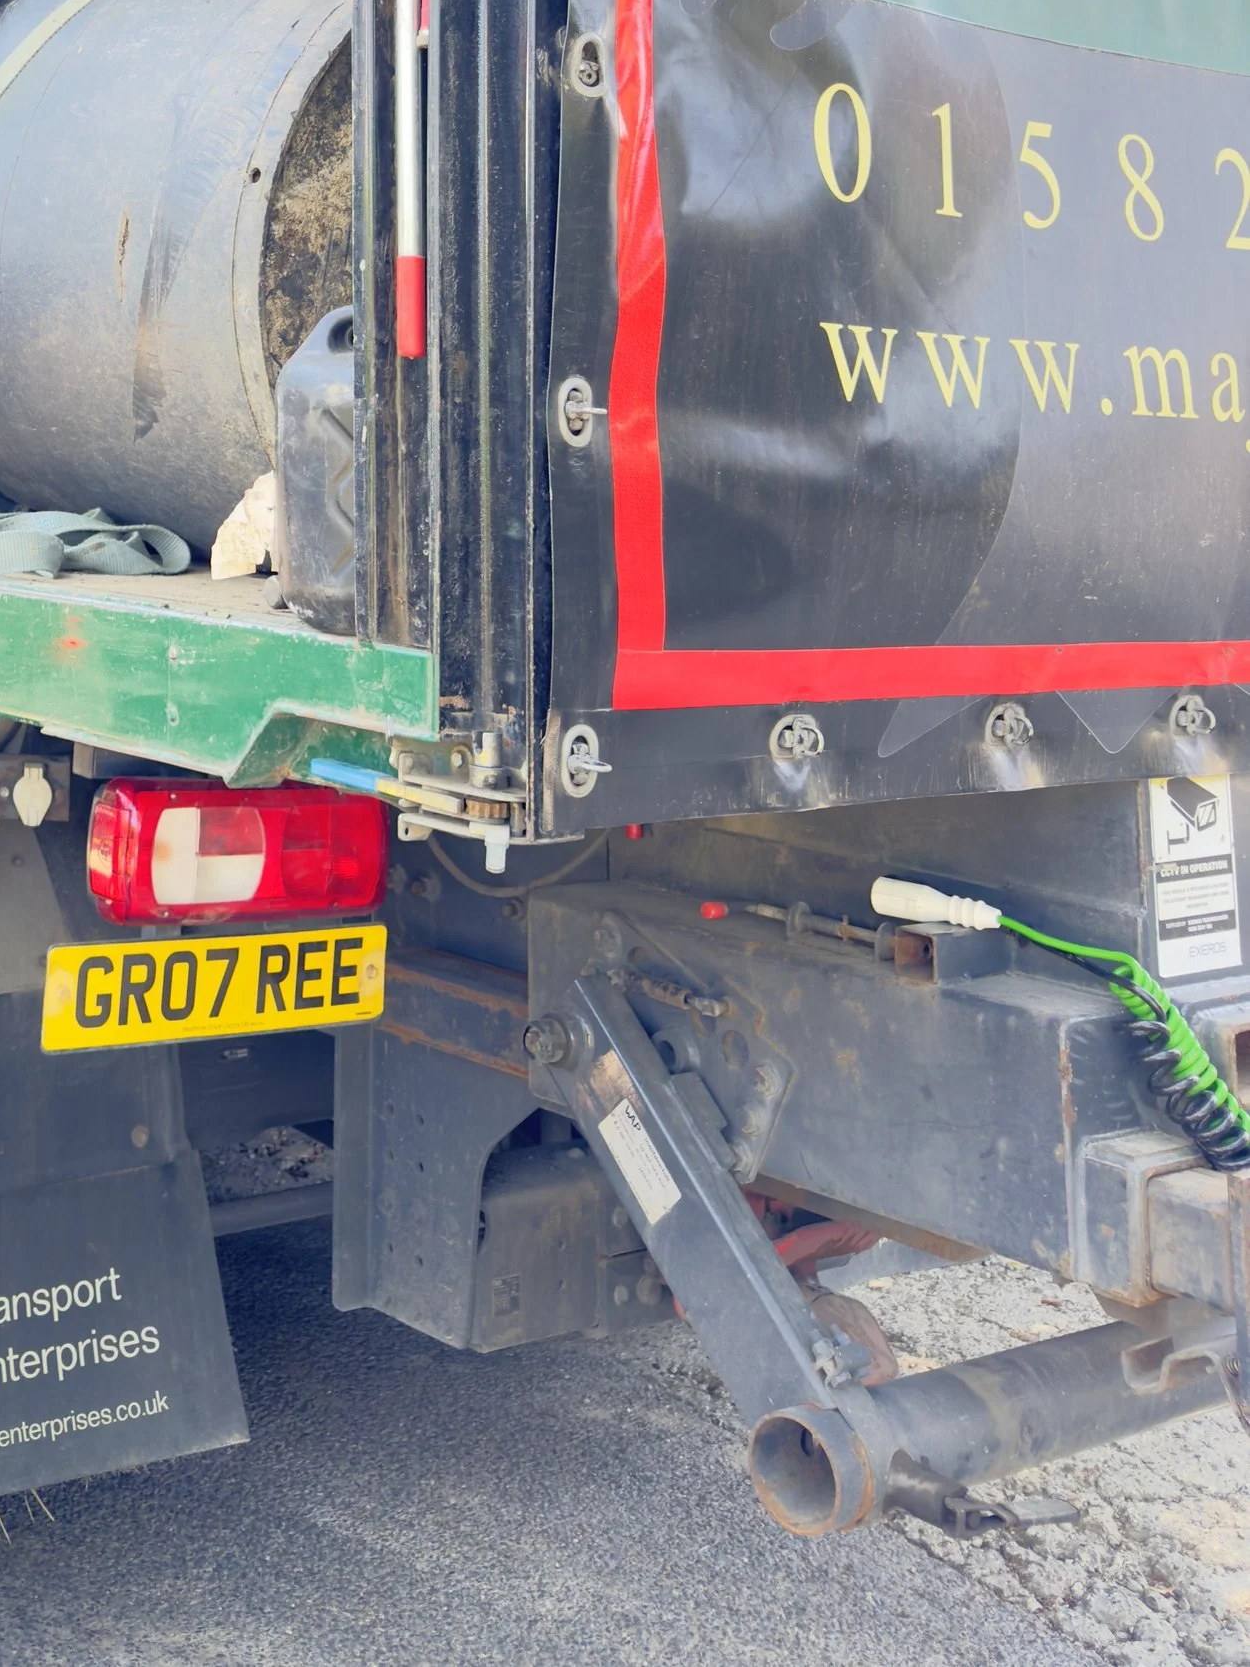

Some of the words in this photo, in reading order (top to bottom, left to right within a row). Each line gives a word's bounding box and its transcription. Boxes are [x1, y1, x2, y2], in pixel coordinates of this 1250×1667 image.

[819, 321, 1250, 453] www.ma
[1180, 864, 1189, 875] IN
[1190, 859, 1228, 874] OPERATION
[256, 936, 364, 1015] REE
